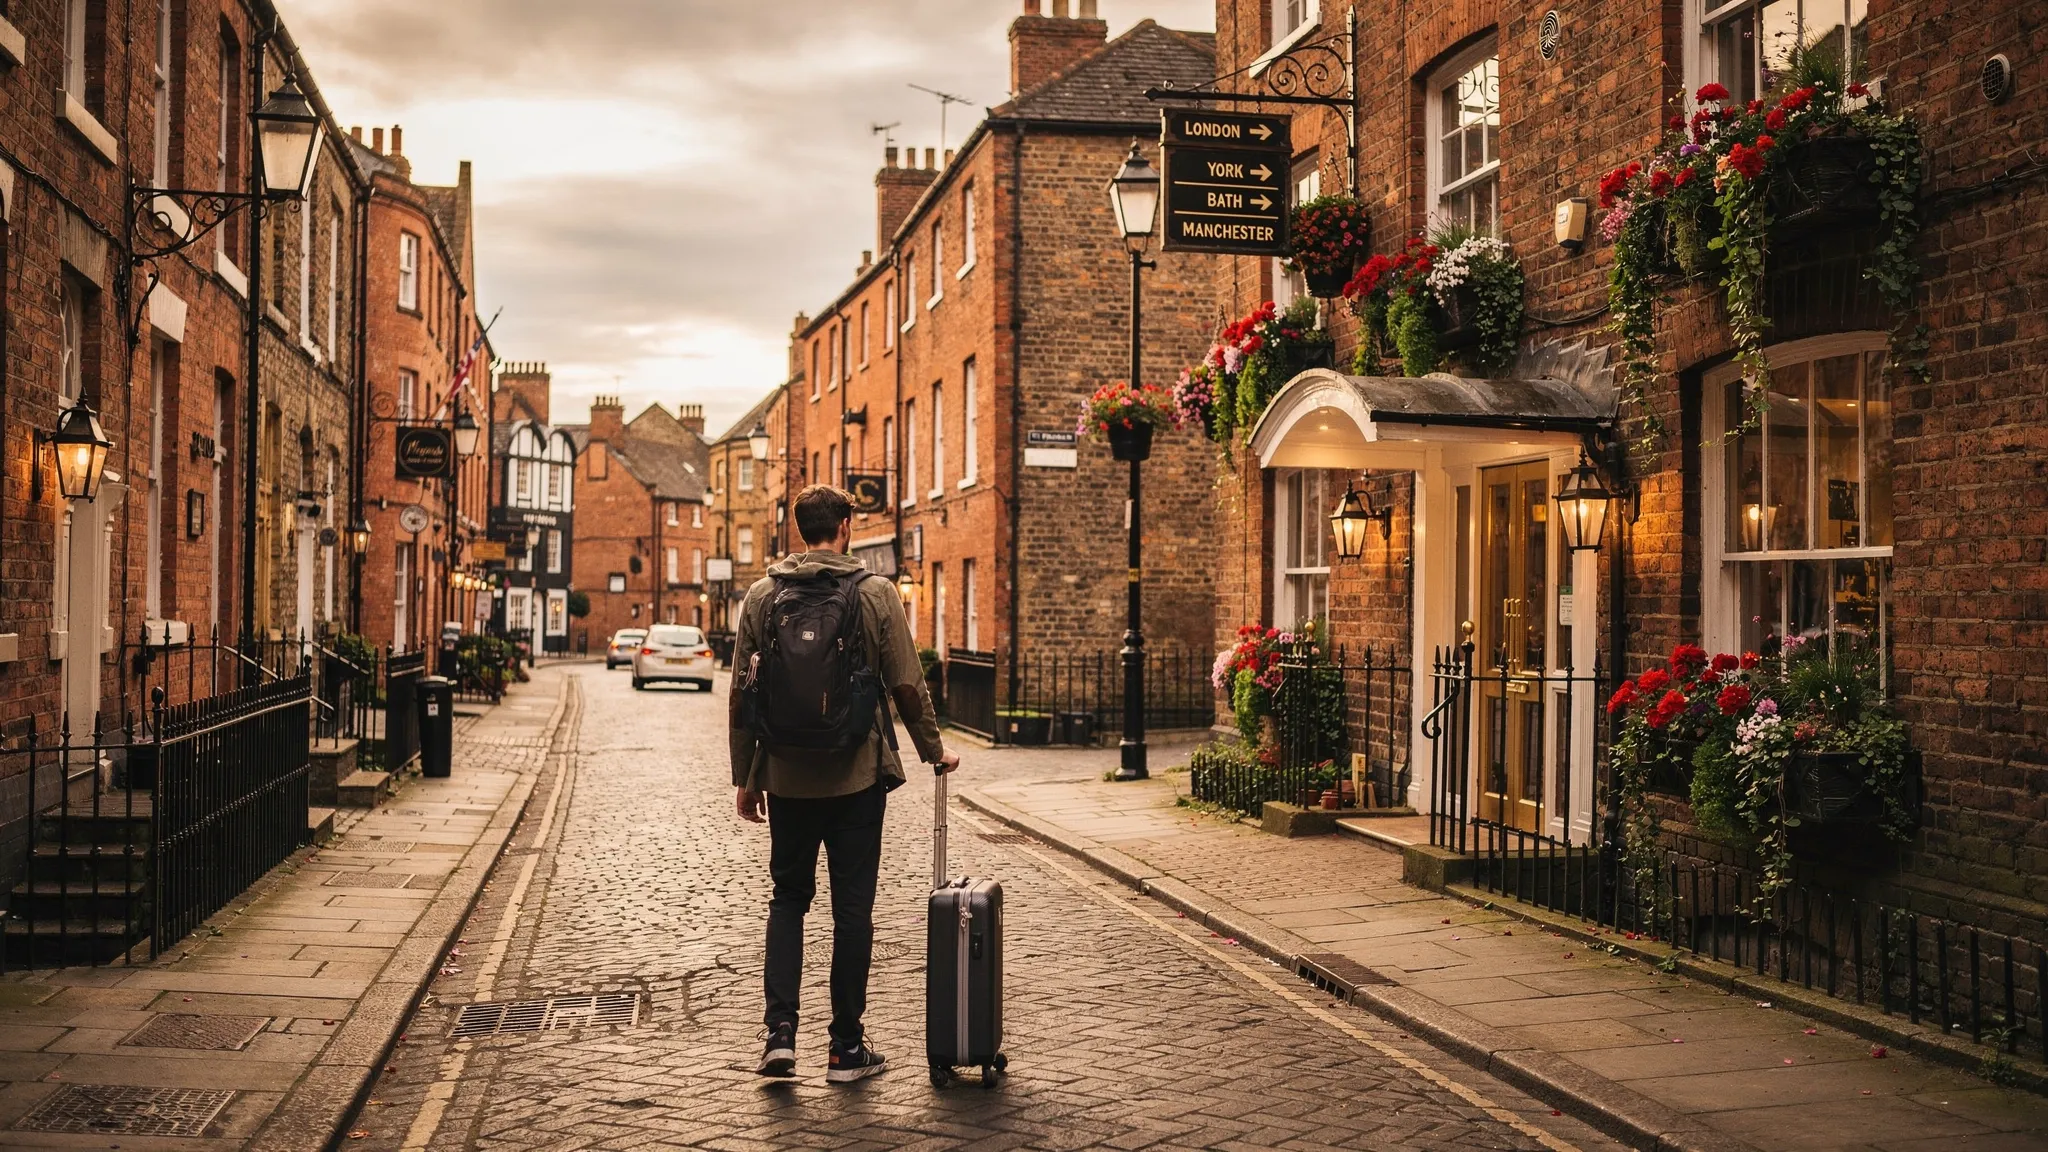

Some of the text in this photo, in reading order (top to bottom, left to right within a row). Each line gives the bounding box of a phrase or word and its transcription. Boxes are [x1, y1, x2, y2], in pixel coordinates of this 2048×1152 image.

[1185, 121, 1241, 138] LONDON
[1207, 161, 1244, 179] YORK
[1207, 192, 1243, 208] BATH
[1183, 221, 1274, 241] MANCHESTER
